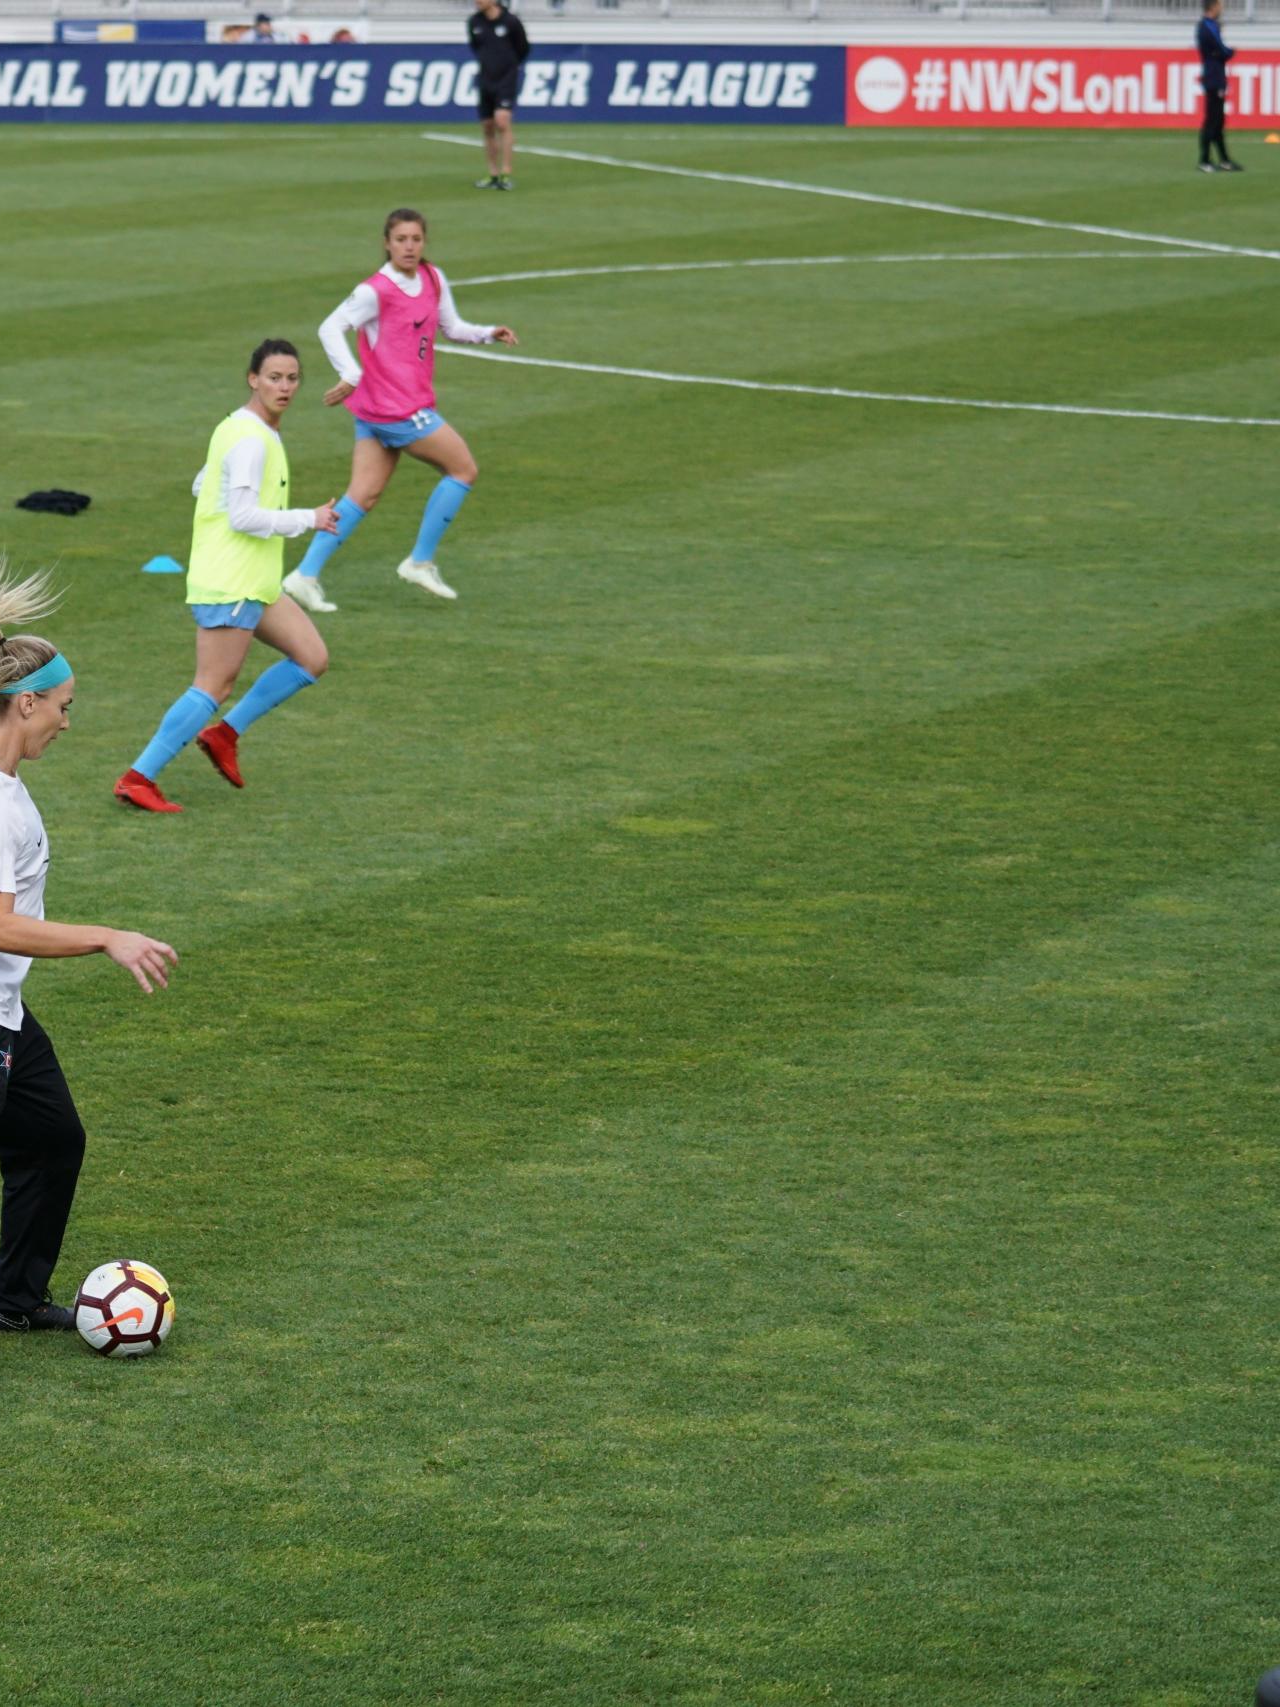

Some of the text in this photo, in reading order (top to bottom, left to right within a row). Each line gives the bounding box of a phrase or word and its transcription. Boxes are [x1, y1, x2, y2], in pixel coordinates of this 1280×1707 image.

[106, 61, 369, 107] WOMEN'S
[384, 61, 592, 106] SOCER
[608, 62, 817, 107] LEAGUE
